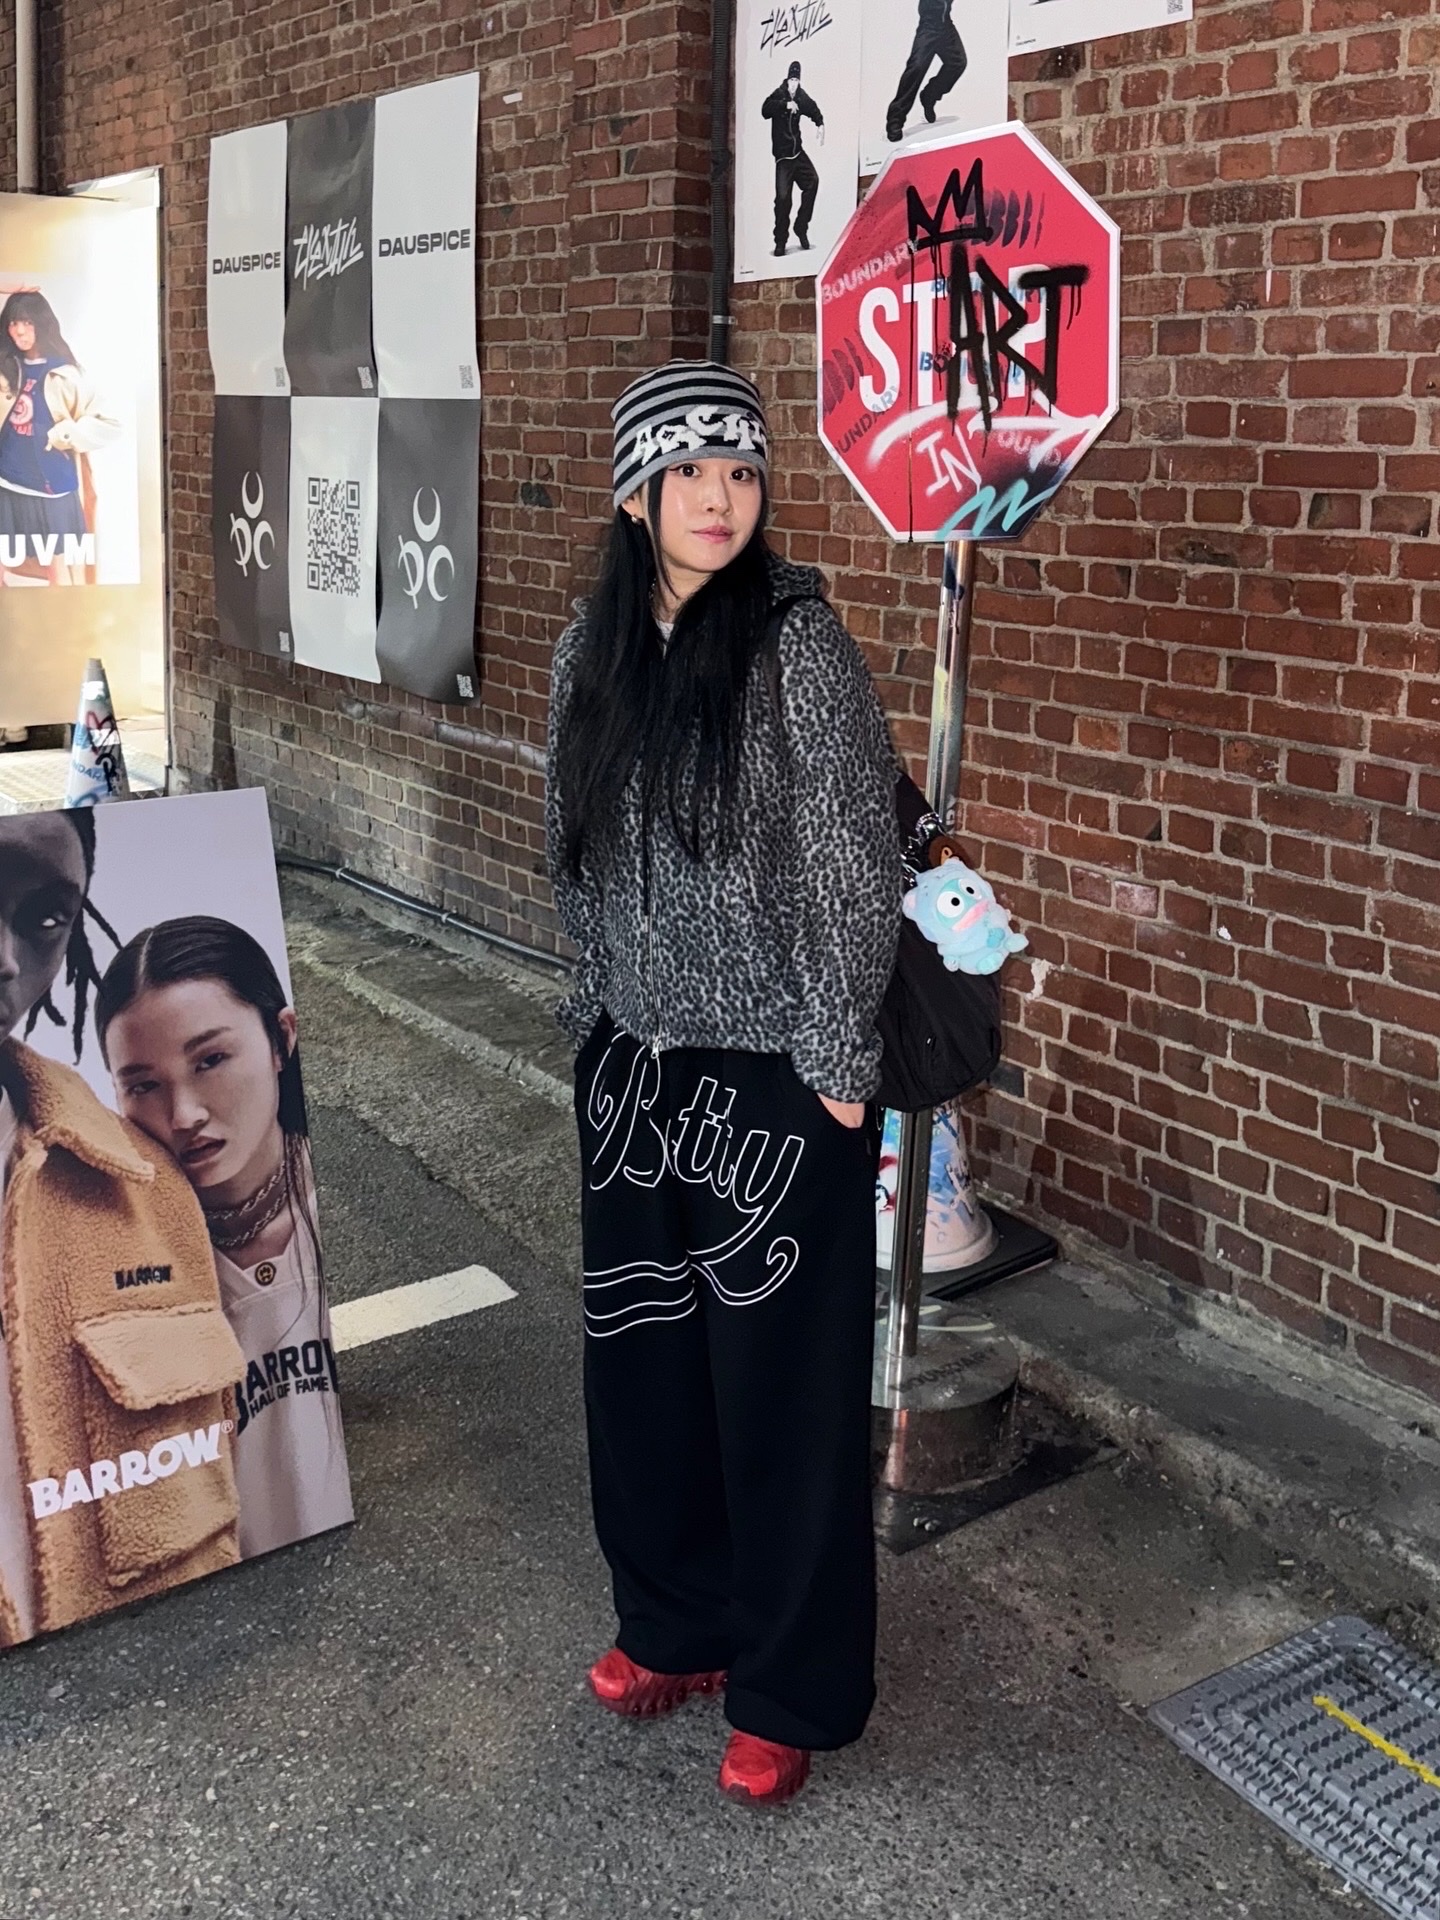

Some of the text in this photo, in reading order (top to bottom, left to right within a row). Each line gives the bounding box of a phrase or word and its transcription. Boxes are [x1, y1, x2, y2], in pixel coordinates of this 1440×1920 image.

[378, 228, 472, 258] DAUSPICE
[212, 251, 282, 275] DAUSPICE
[947, 242, 1090, 428] ART
[115, 1264, 173, 1290] BARROW
[277, 1382, 291, 1398] OF
[296, 1376, 329, 1394] FAME
